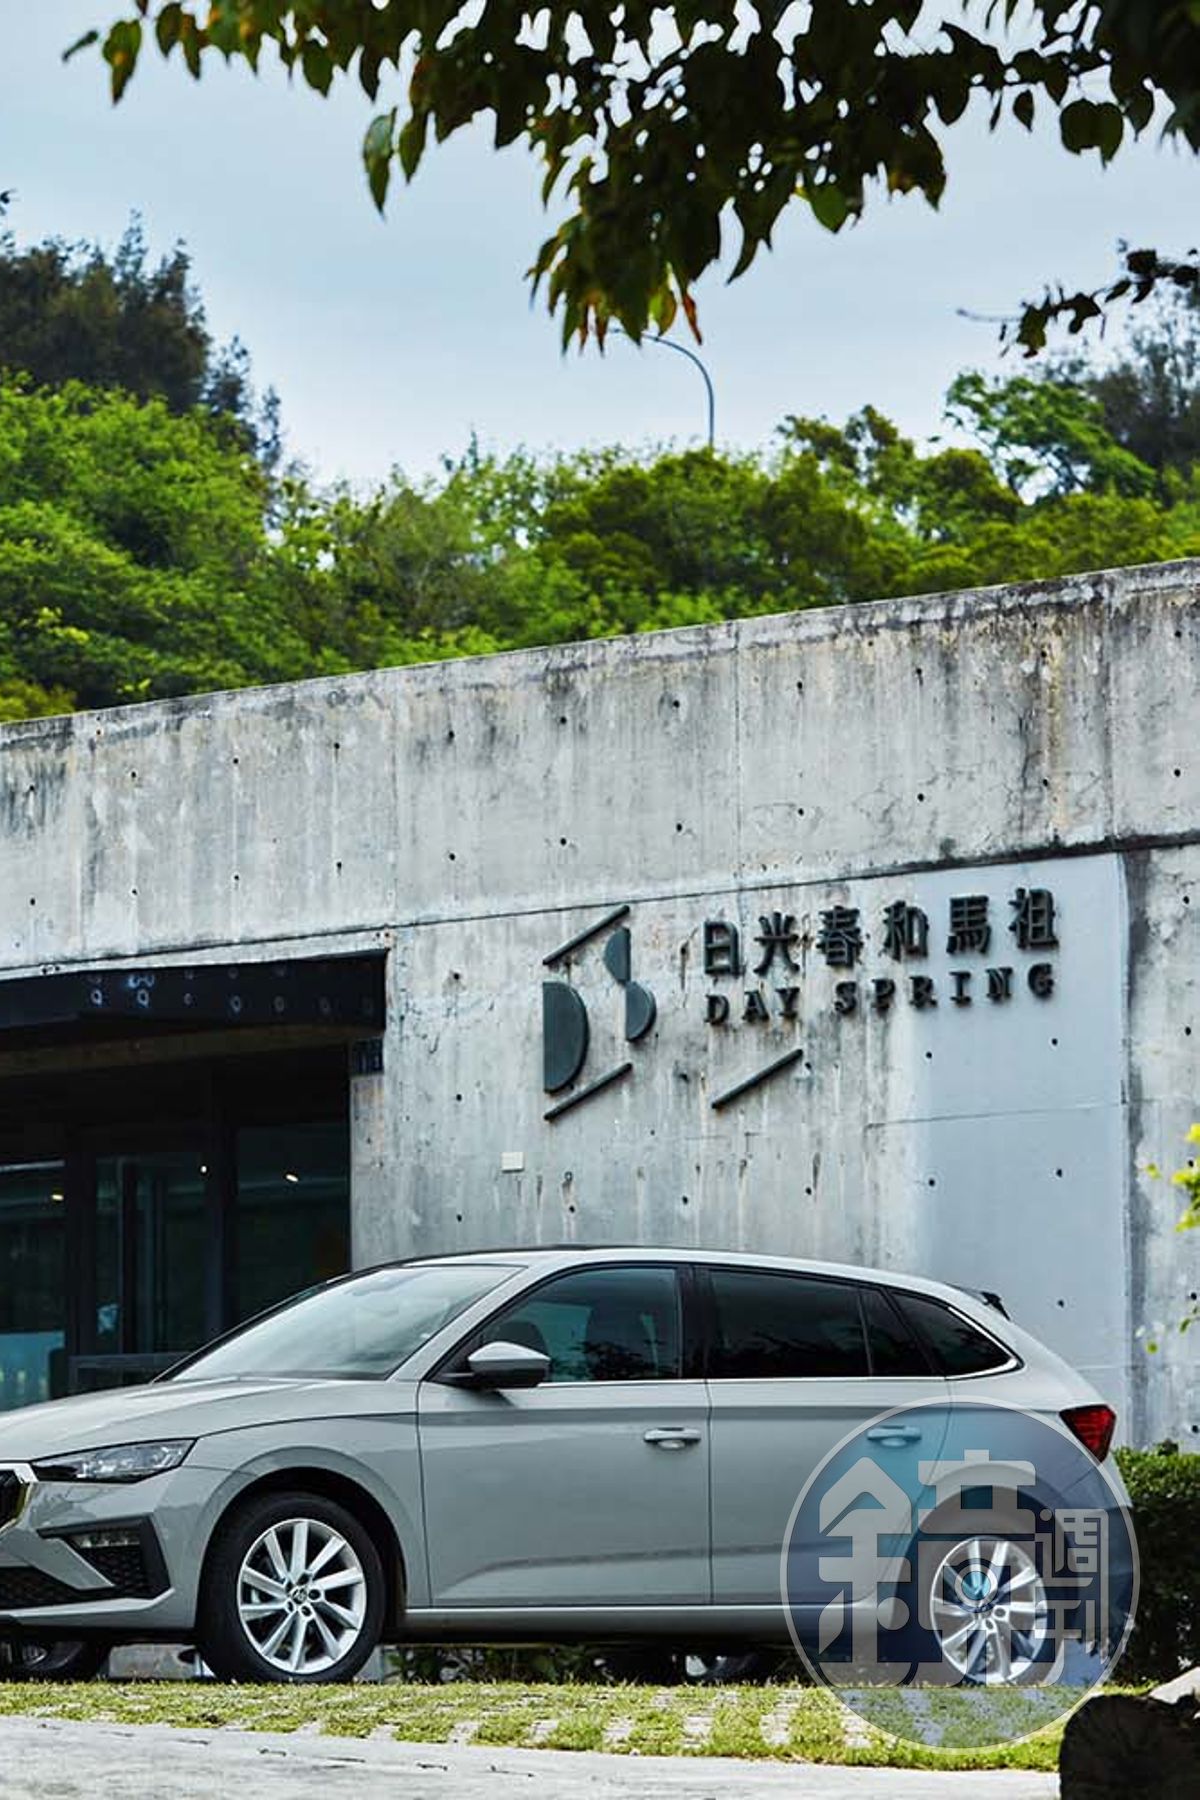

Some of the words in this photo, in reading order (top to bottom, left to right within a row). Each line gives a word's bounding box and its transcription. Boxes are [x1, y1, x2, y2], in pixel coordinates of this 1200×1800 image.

[703, 887, 1059, 977] 日光春和馬祖
[704, 986, 800, 1025] DAY
[835, 963, 1055, 1015] SPRING
